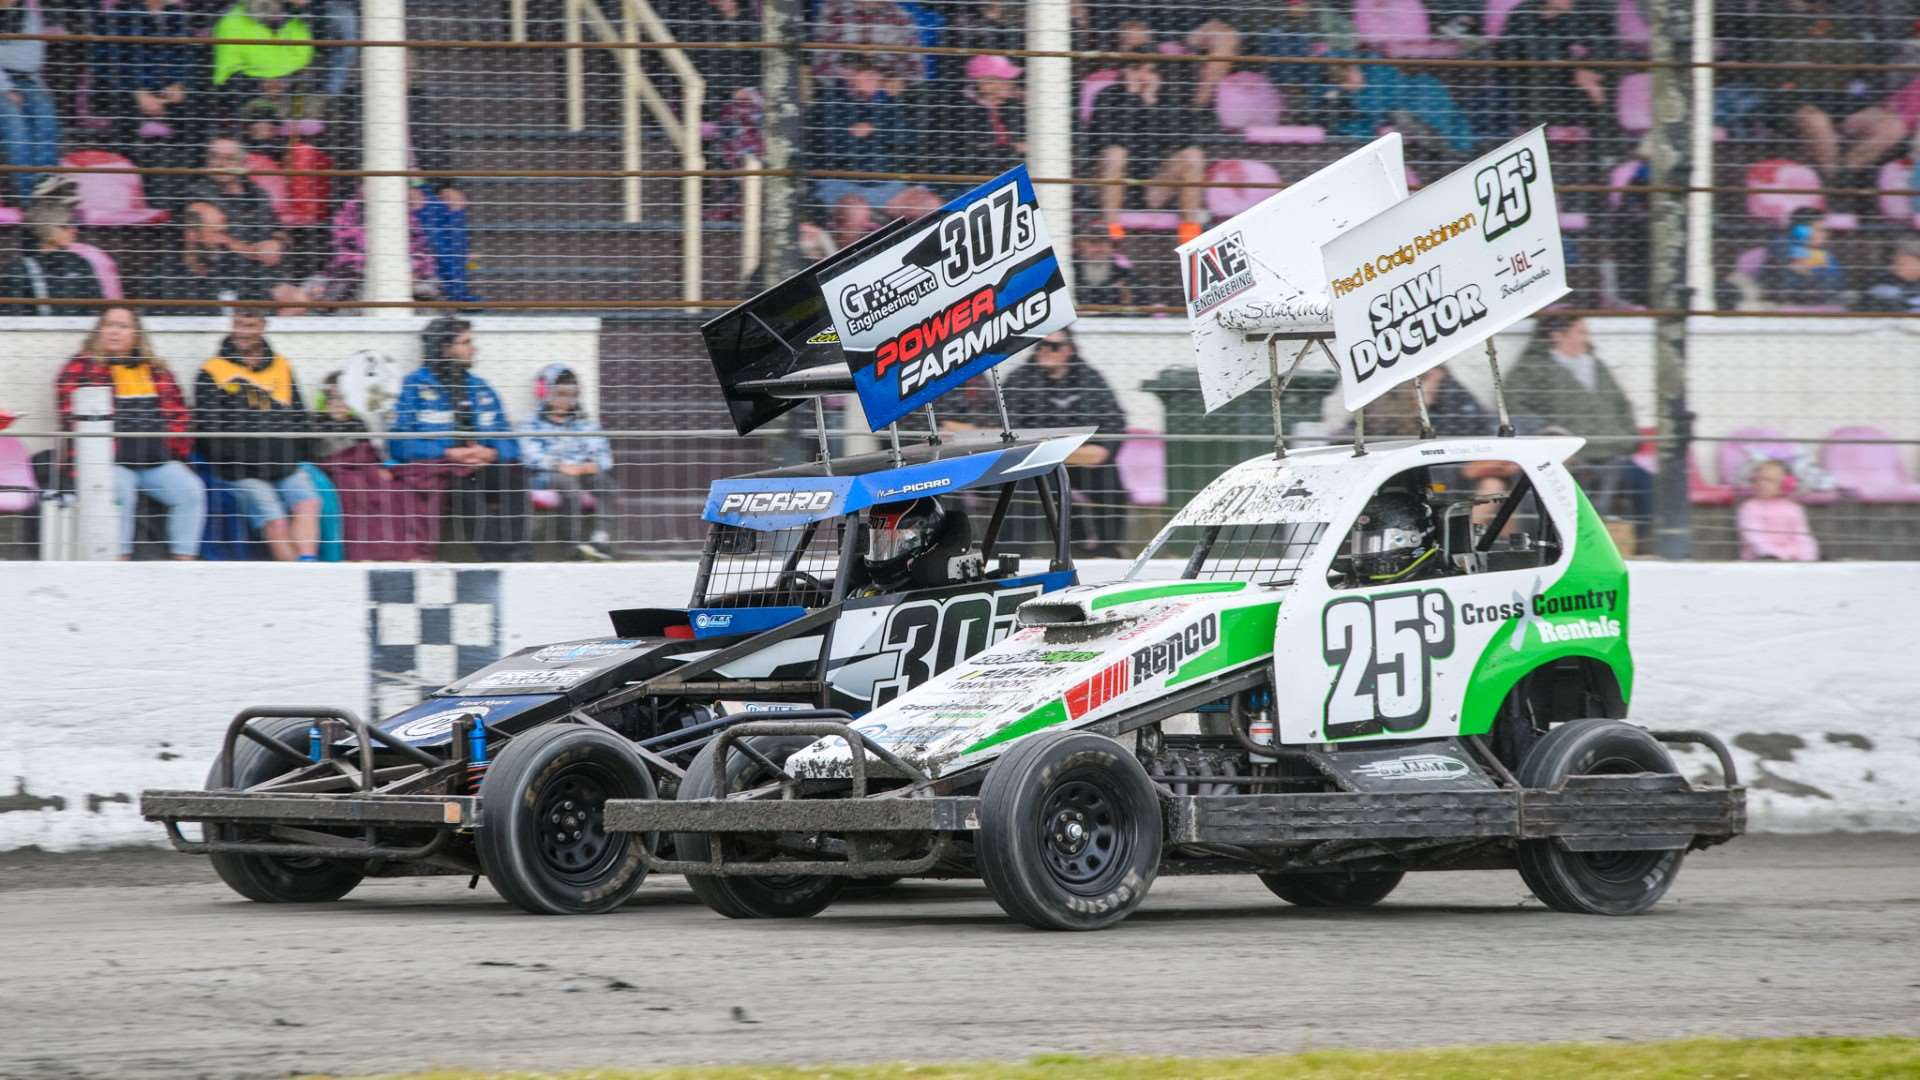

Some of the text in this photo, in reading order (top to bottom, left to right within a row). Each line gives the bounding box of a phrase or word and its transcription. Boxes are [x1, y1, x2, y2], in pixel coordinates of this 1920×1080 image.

[1331, 212, 1477, 299] Fred & Craig Robinson
[1510, 250, 1532, 276] J&L
[841, 283, 872, 320] GT
[847, 275, 939, 336] Engineering Ltd
[1194, 271, 1254, 312] ENGINEERING
[1369, 264, 1441, 337] SAW
[876, 287, 995, 376] POWER
[901, 291, 1048, 396] FARMING
[1350, 283, 1488, 383] DOCTOR
[719, 490, 834, 514] PICARD
[903, 478, 951, 493] PICARD
[1461, 589, 1617, 626] Cross Country
[1536, 615, 1621, 643] Rentals
